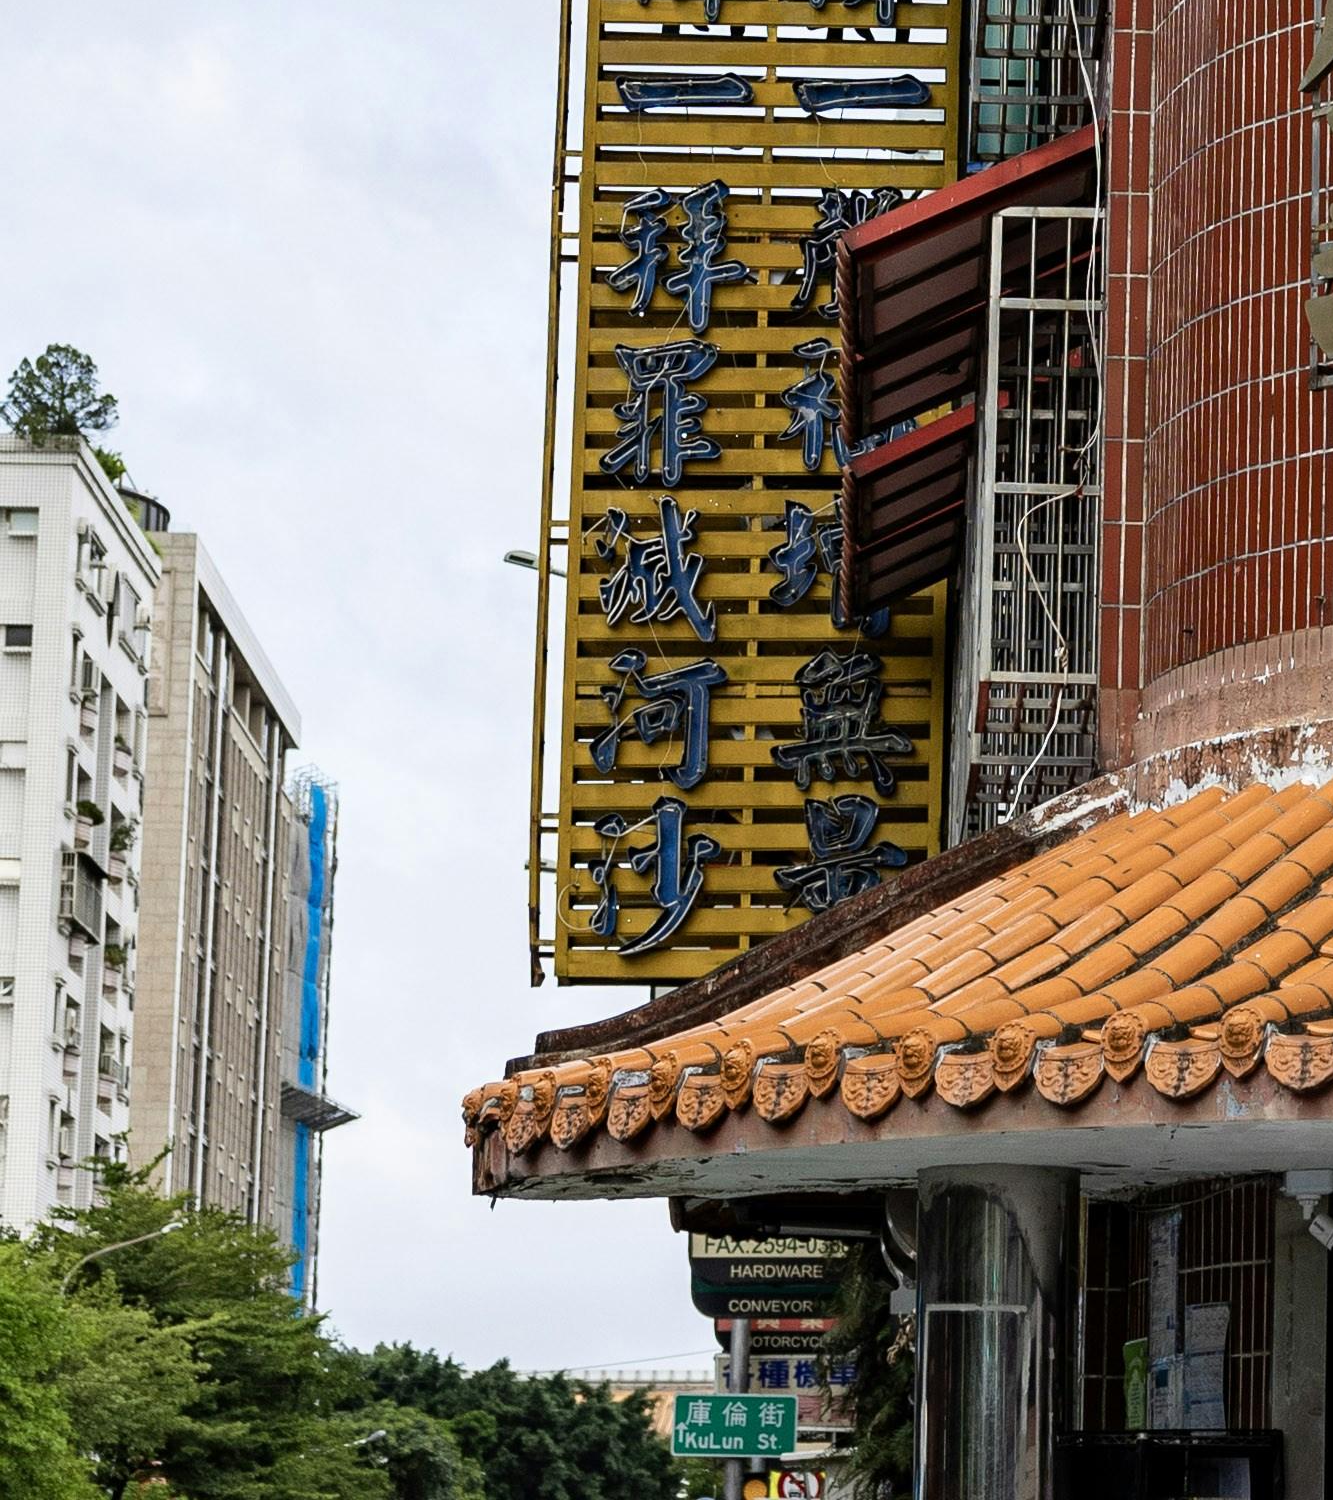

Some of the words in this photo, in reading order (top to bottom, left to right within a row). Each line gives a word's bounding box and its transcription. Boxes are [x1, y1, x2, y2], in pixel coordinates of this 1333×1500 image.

[730, 1264, 824, 1279] HARDWARE
[728, 1299, 814, 1313] CONVEYOR
[686, 1399, 785, 1428] 庫倫街
[684, 1431, 744, 1450] KuLun
[757, 1432, 782, 1450] St.
